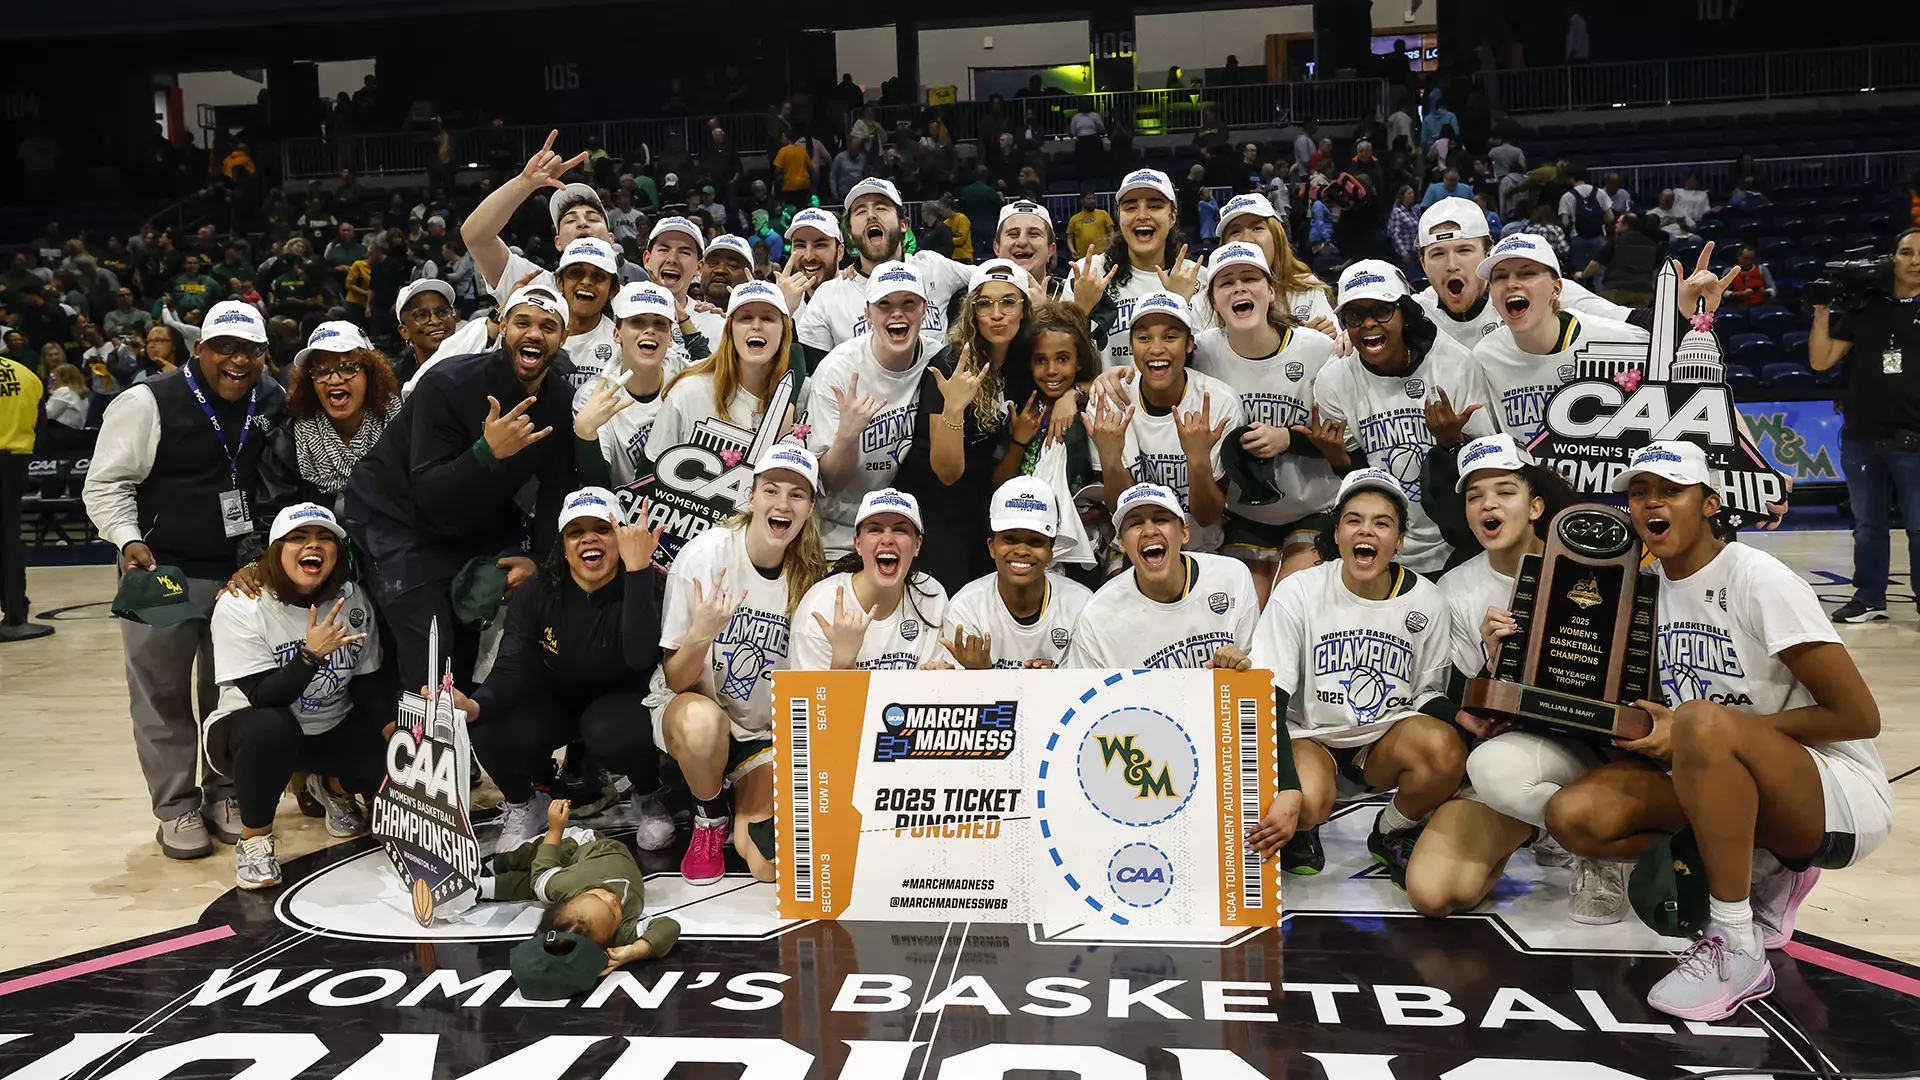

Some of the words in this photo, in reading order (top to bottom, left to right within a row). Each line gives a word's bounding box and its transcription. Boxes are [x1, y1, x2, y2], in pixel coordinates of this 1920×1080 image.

[1095, 32, 1134, 59] 106
[544, 63, 579, 90] 105
[0, 368, 17, 382] ENT
[0, 383, 20, 396] AFF
[1503, 385, 1544, 397] WOMEN'S
[1255, 393, 1305, 407] BASKETBALL
[1547, 380, 1735, 445] CAA
[1553, 443, 1623, 458] WOMEN'S
[1741, 413, 1840, 479] W&M
[28, 460, 58, 470] CAA
[865, 461, 892, 472] 2025
[654, 488, 709, 516] WOMEN'S
[1566, 519, 1622, 542] CAA
[1571, 616, 1590, 625] 2025
[1321, 628, 1364, 642] WOMEN'S
[1559, 626, 1598, 640] WOMEN'S
[1673, 622, 1731, 638] BASKETBALL
[1143, 641, 1185, 667] WOMEN'S
[1550, 637, 1603, 654] BASKETBALL
[1550, 650, 1599, 666] CHAMPIONS
[1548, 667, 1564, 678] TOM
[1565, 670, 1596, 682] YEAGER
[1555, 676, 1586, 687] TROPHY
[817, 686, 826, 700] 25
[1317, 690, 1344, 704] 2025
[1709, 693, 1753, 706] CAA
[817, 702, 827, 731] SEAT
[905, 708, 979, 728] MARCH
[1220, 684, 1231, 743] QUALIFIER
[1539, 701, 1568, 713] WILLIAM
[1575, 708, 1596, 719] MARY
[914, 729, 1013, 750] MADNESS
[387, 729, 458, 809] CAA
[1093, 734, 1181, 800] W&M
[819, 771, 828, 785] 16
[1221, 746, 1234, 812] AUTOMATIC
[388, 787, 417, 810] WOMEN'S
[417, 801, 457, 828] BASKETBALL
[820, 787, 829, 813] ROW
[875, 788, 936, 812] 2025
[943, 788, 1021, 812] TICKET
[895, 814, 1001, 839] PUNCHED
[372, 795, 478, 882] CHAMPIONSHIP
[821, 853, 830, 862] 3
[1223, 813, 1235, 888] TOURNAMENT
[403, 849, 426, 871] WASHINGTON,
[429, 865, 439, 875] D.C.
[901, 878, 995, 890] #MARCHMADNESS
[1116, 867, 1165, 883] CAA
[821, 863, 831, 913] SECTION
[890, 897, 1008, 910] @MARCHMADNESSWBB
[1226, 892, 1237, 921] NCAA
